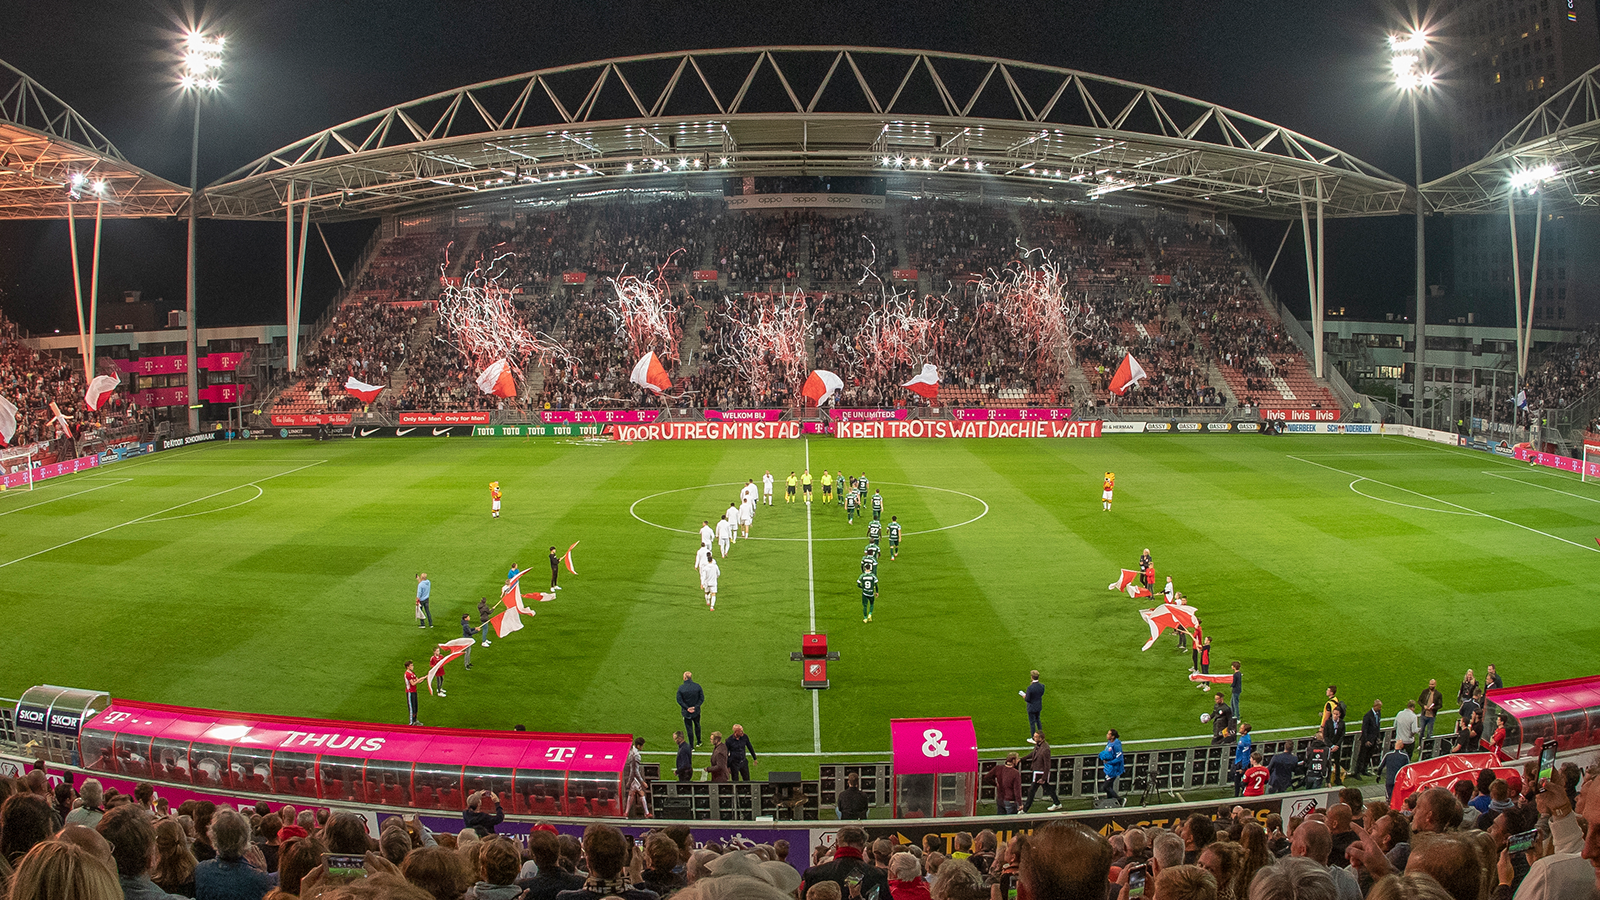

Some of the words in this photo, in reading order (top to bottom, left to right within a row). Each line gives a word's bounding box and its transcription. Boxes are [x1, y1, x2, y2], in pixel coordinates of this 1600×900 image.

[792, 196, 817, 204] oppo
[827, 196, 852, 204] oppo
[853, 411, 895, 419] UNLIMITEDS
[1267, 410, 1286, 420] livis
[1291, 410, 1310, 420] livis
[1315, 410, 1334, 420] livis
[477, 427, 494, 435] TOTO
[502, 427, 520, 435] TOTO
[528, 427, 545, 435] TOTO
[553, 427, 571, 435] TOTO
[579, 427, 597, 435] TOTO
[617, 425, 660, 440] VOOR
[661, 423, 719, 439] UTREG
[753, 422, 800, 439] STAD
[837, 421, 850, 438] IK
[852, 421, 884, 438] BEN
[888, 420, 946, 438] TROTS
[949, 421, 987, 438] WAT
[988, 420, 1048, 438] DACHIE
[864, 581, 871, 589] 9
[19, 710, 45, 722] SKOR
[51, 714, 78, 727] SKOR
[280, 730, 386, 751] THUIS
[922, 729, 950, 758] &
[1312, 763, 1323, 771] HB
[1253, 776, 1262, 789] 2
